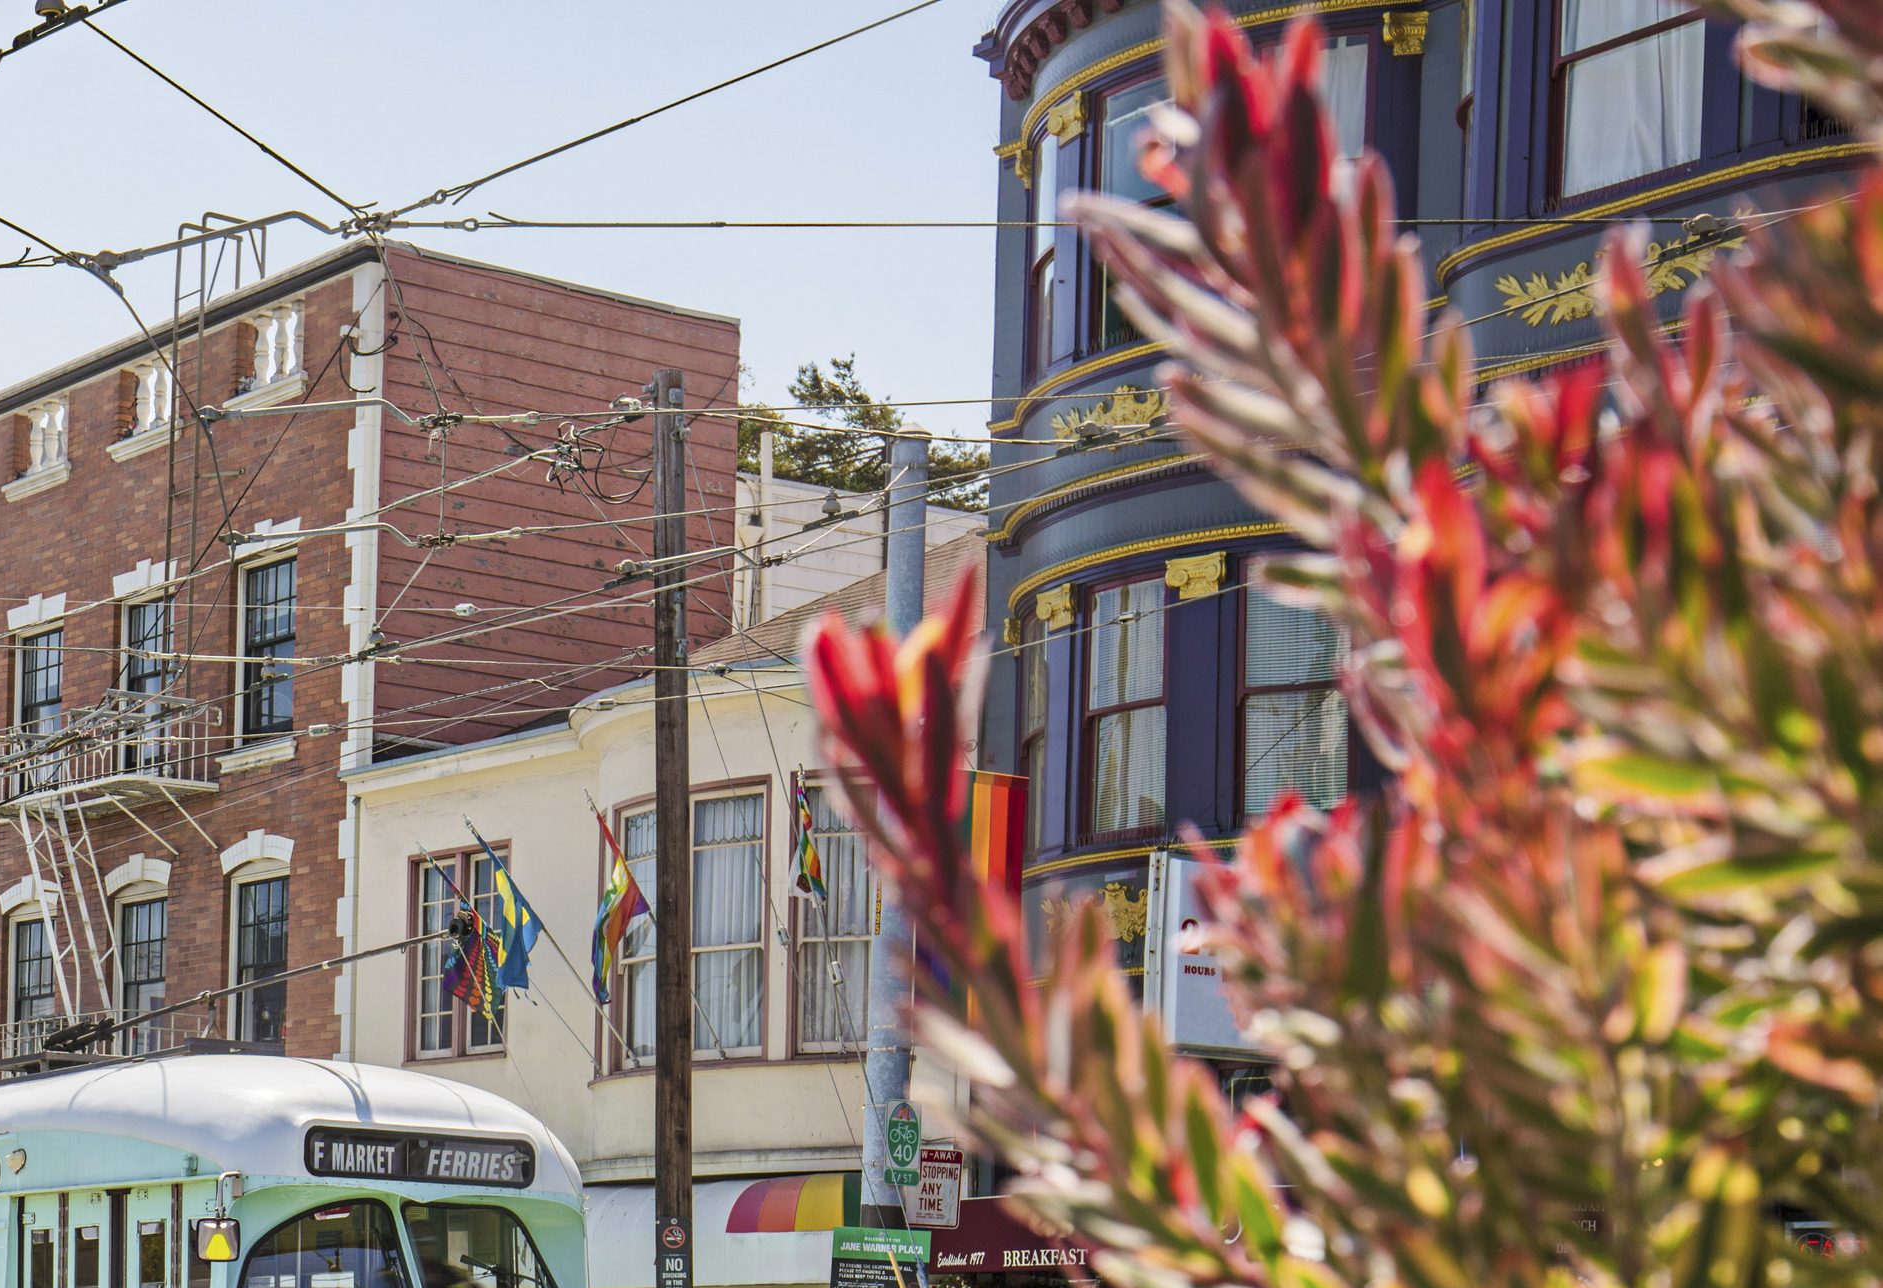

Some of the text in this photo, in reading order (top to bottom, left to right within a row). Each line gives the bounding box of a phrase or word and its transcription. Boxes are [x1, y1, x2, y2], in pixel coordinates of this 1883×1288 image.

[1184, 965, 1216, 976] HOURS
[893, 1144, 913, 1161] 40
[921, 1150, 957, 1160] W-AWAY
[314, 1141, 516, 1181] F MARKET FERRIES
[922, 1165, 958, 1180] STOPPING
[921, 1182, 942, 1196] ANY
[919, 1197, 943, 1211] TIME
[840, 1242, 861, 1251] JANE
[665, 1258, 683, 1271] NO
[937, 1252, 985, 1268] Established 1977
[1003, 1248, 1088, 1267] BREAKFAST
